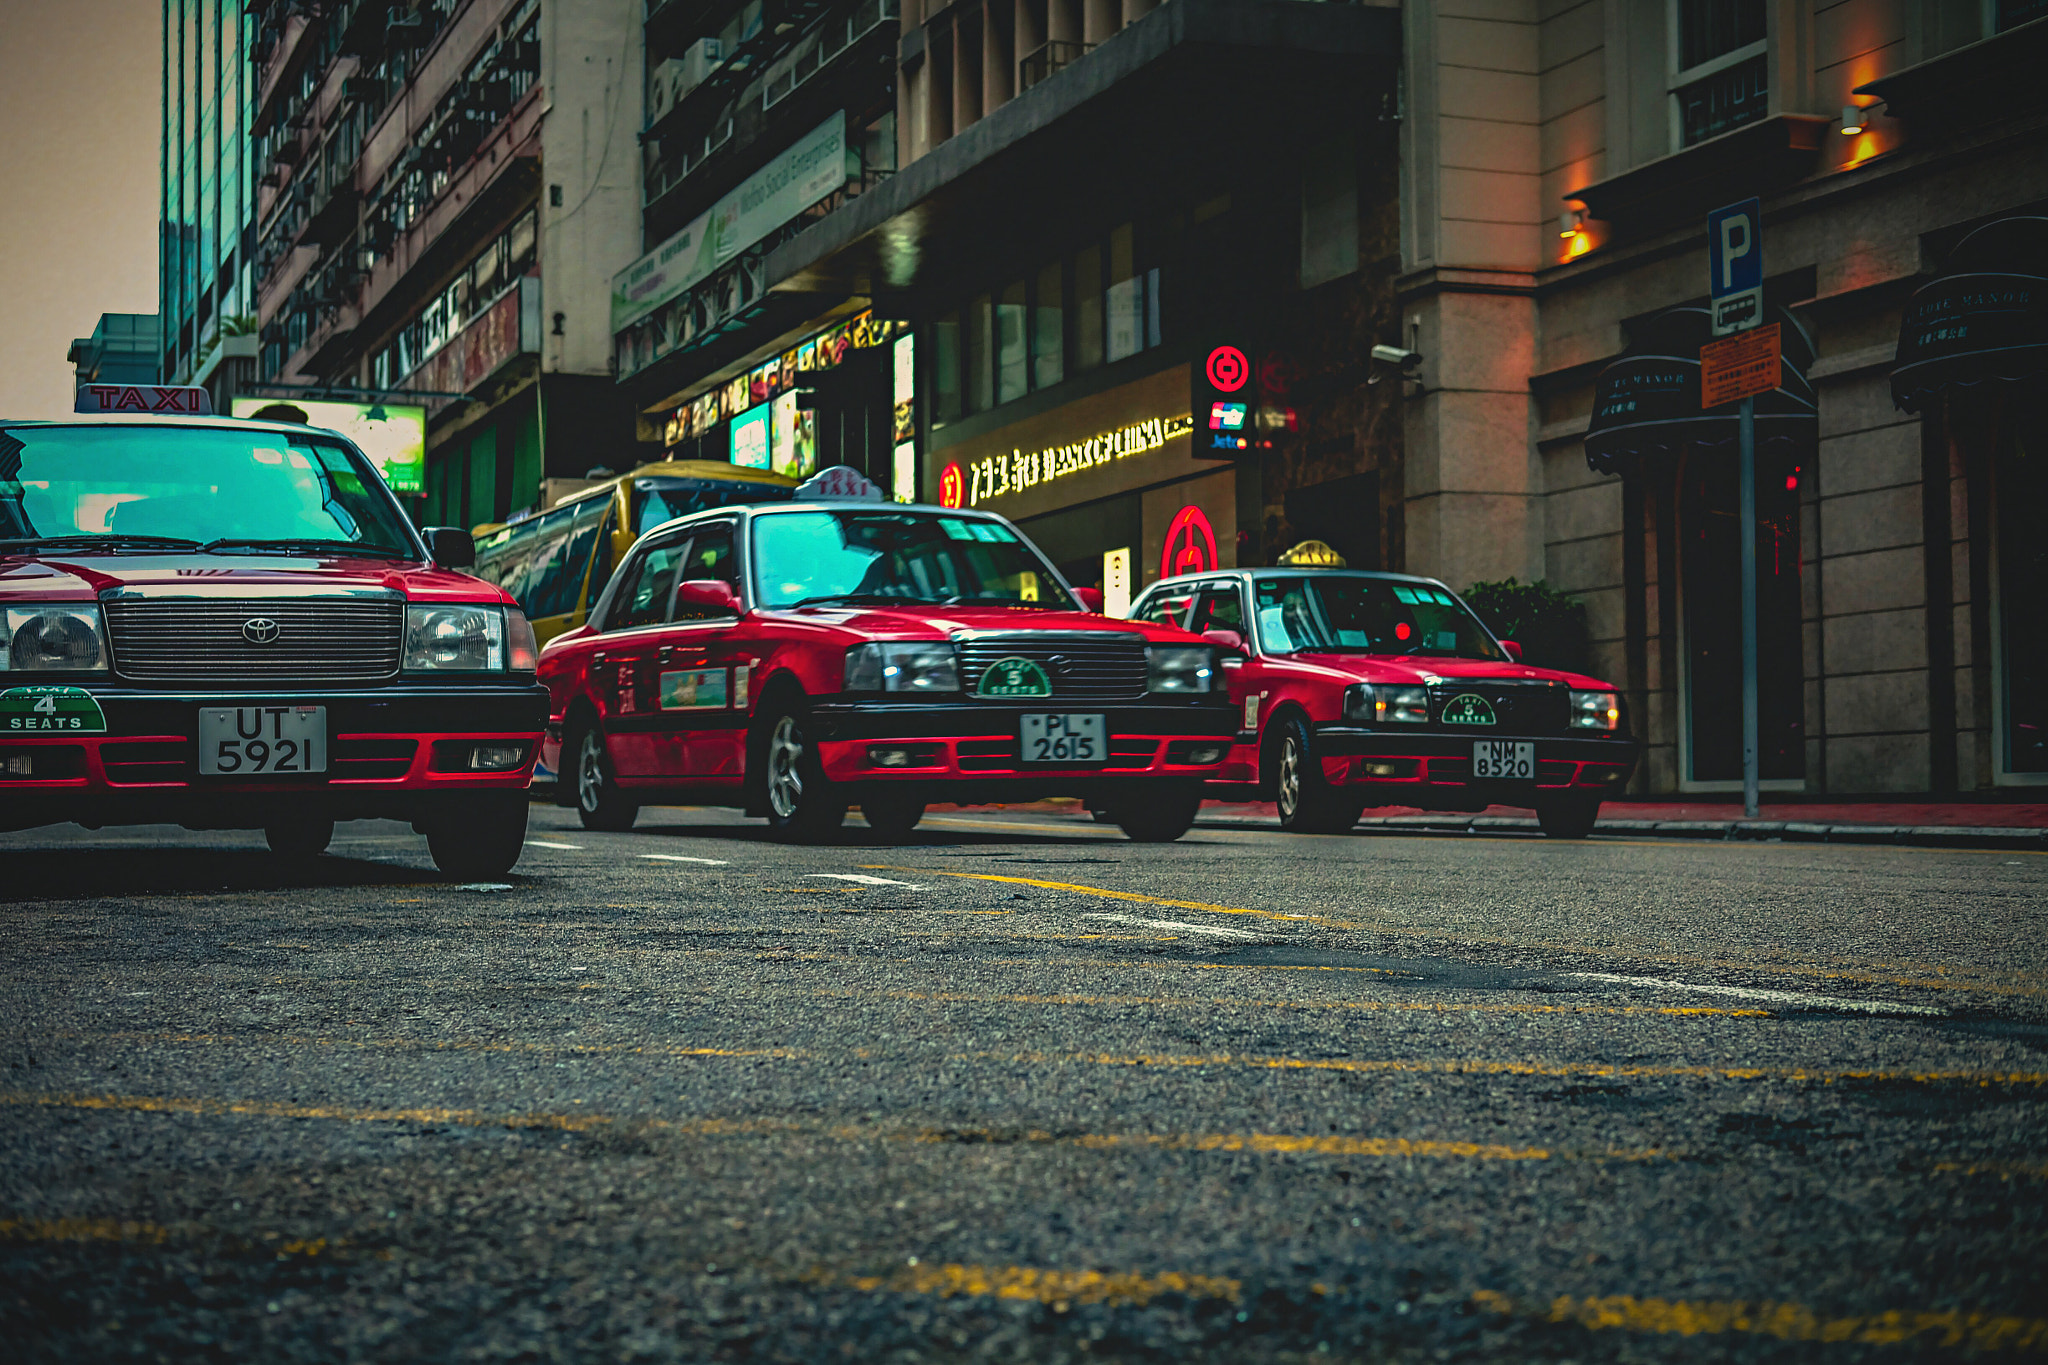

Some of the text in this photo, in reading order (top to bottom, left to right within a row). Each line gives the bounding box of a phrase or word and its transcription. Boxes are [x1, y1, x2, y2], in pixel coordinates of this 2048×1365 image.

[1721, 213, 1750, 288] P
[1961, 290, 2030, 307] MANOR
[90, 385, 200, 412] TAXI
[817, 480, 868, 496] TAXI
[1007, 670, 1023, 685] 5
[990, 685, 1039, 694] SEATS
[33, 694, 57, 716] 4
[1464, 704, 1474, 716] 5
[10, 717, 82, 729] SEATS
[236, 707, 290, 740] UT
[1046, 714, 1081, 737] PL
[217, 739, 311, 773] 5921
[1033, 737, 1094, 760] 2615
[1490, 741, 1516, 760] NM
[1477, 758, 1530, 777] 8520
